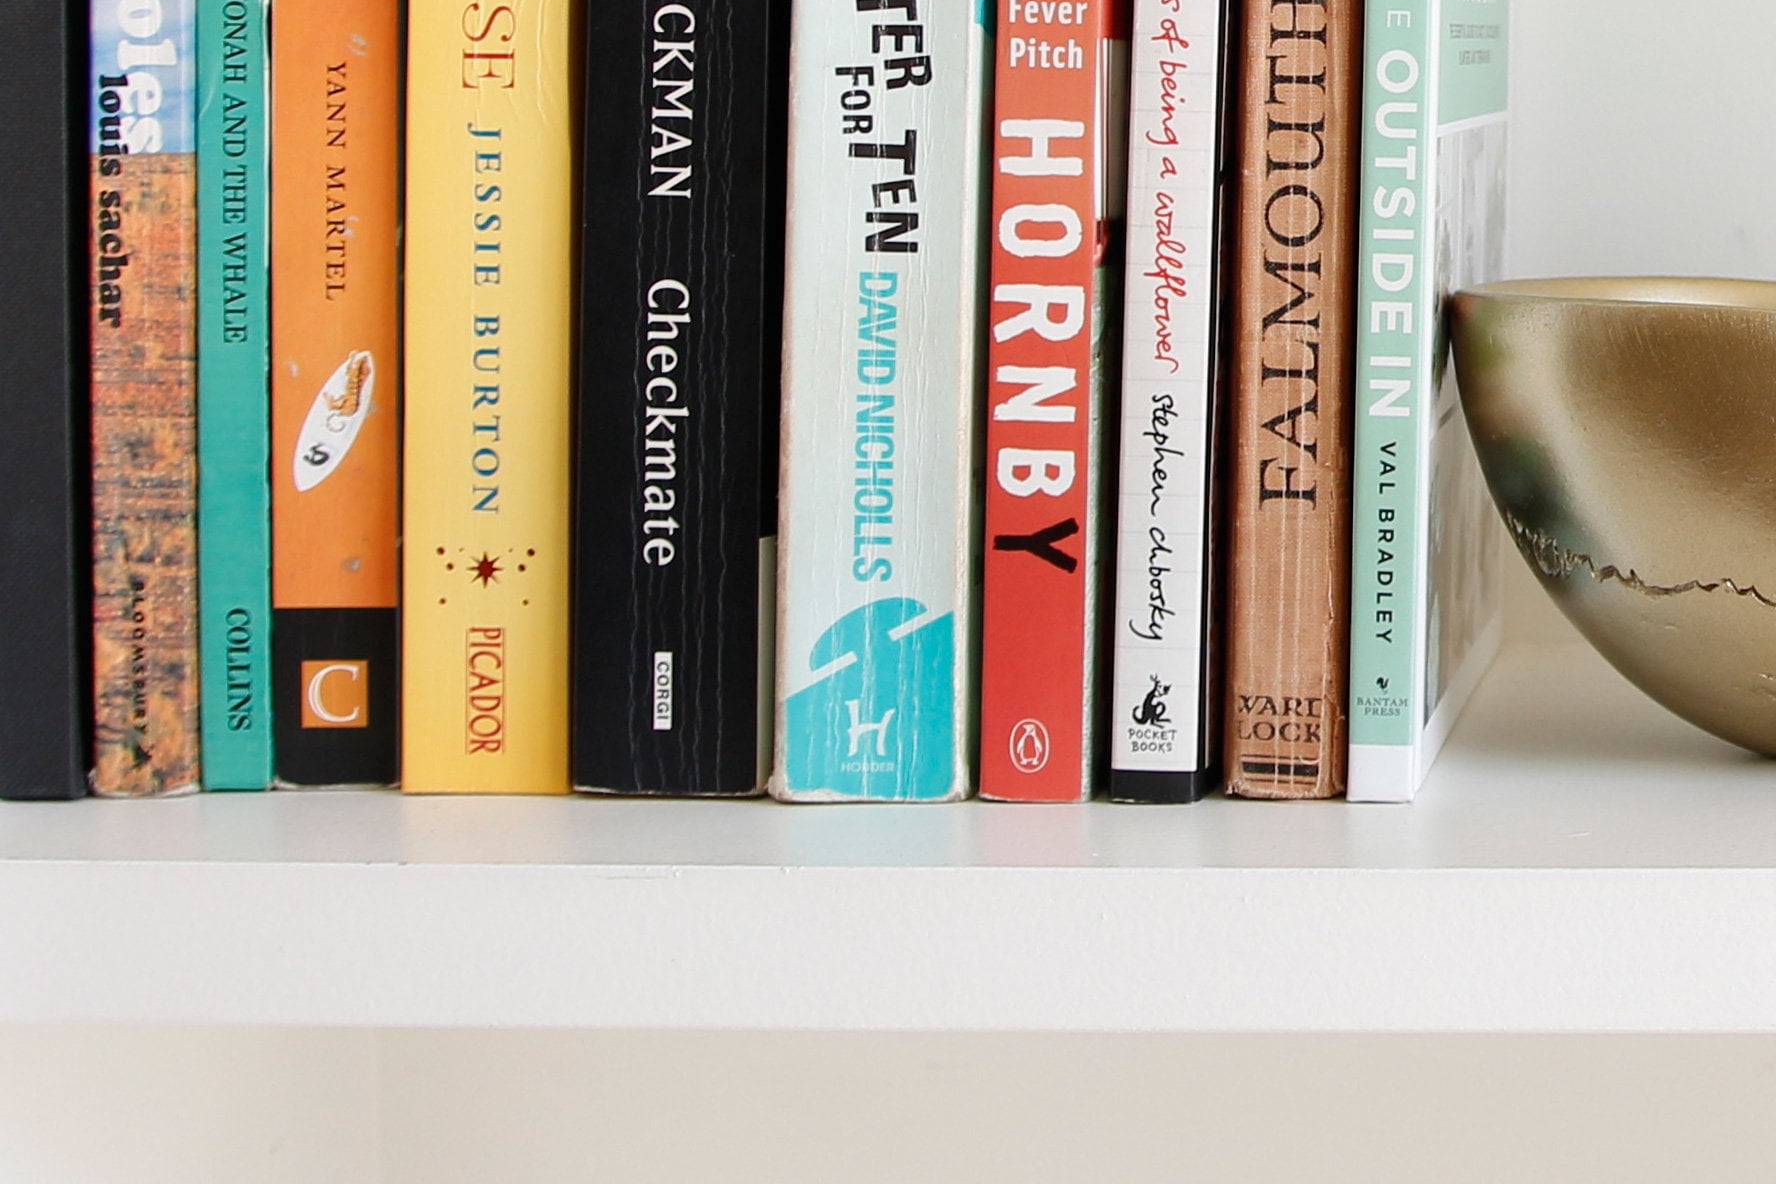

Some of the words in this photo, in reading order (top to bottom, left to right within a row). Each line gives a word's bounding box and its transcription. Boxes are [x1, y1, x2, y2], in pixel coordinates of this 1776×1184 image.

[1008, 38, 1085, 69] Pitch
[1148, 17, 1190, 56] of
[99, 75, 128, 177] louis
[222, 96, 249, 157] AND
[327, 62, 347, 149] YANN
[835, 65, 874, 136] FOR
[1145, 59, 1187, 145] being
[222, 161, 249, 224] THE
[467, 122, 502, 286] JESSIE
[848, 130, 919, 254] TEN
[1160, 157, 1178, 180] a
[1371, 48, 1420, 337] OUTSIDE
[98, 190, 129, 328] sachar
[325, 165, 346, 301] MARTEL
[1142, 190, 1188, 374] wallflower
[222, 232, 250, 344] WHALE
[857, 271, 899, 385] DAVID
[992, 120, 1086, 573] HORNBY
[1369, 356, 1411, 418] IN
[472, 314, 502, 514] BURTON
[643, 278, 691, 567] Checkmate
[1143, 393, 1184, 516] stephen
[852, 393, 897, 583] NICHOLLS
[1377, 442, 1399, 495] VAL
[1129, 526, 1177, 643] chbosky
[1376, 509, 1396, 644] BRADLEY
[131, 579, 146, 735] BLOOMSBURY
[227, 608, 252, 731] COLLINS
[308, 665, 361, 723] C
[469, 627, 502, 754] PICADOR
[657, 660, 670, 723] CORGI
[1357, 697, 1409, 708] BANTAM
[1128, 729, 1177, 741] POCKET
[1131, 742, 1173, 753] BOOKS
[1238, 721, 1321, 743] LOCK
[1364, 708, 1400, 716] PRESS
[841, 761, 895, 773] HODDER
